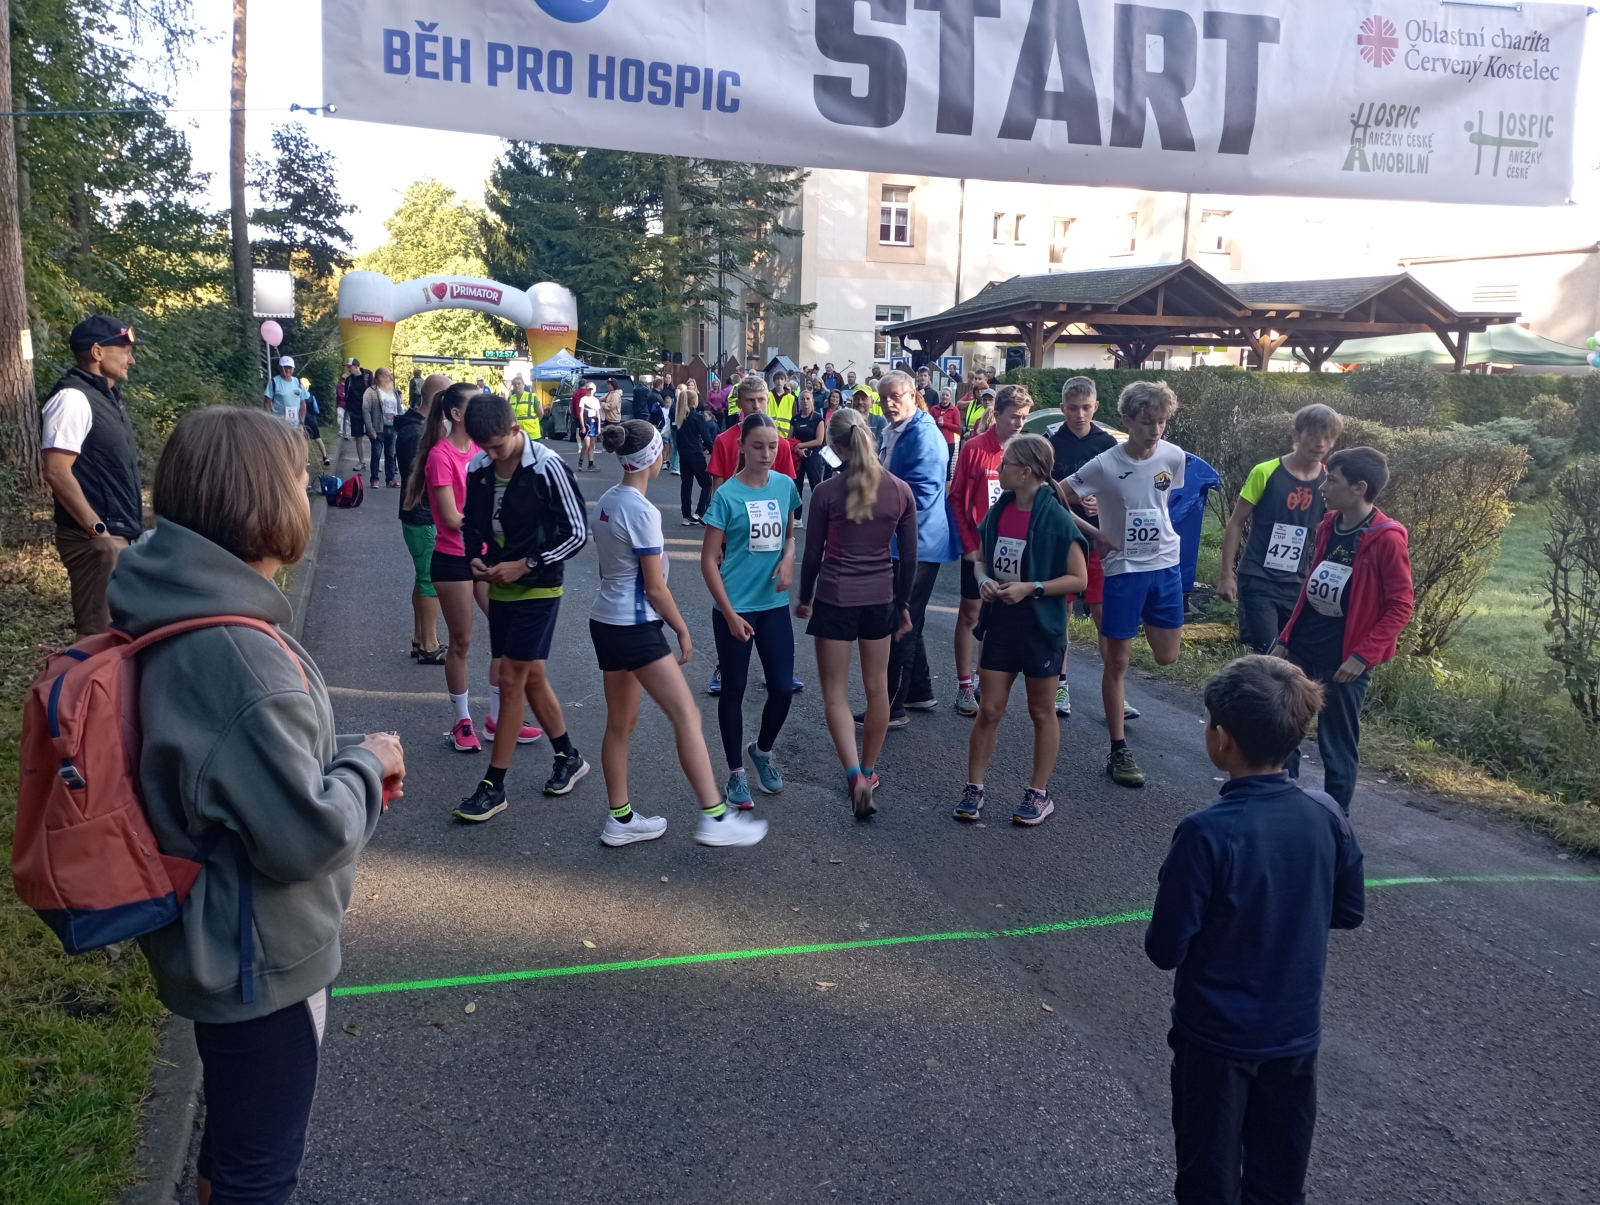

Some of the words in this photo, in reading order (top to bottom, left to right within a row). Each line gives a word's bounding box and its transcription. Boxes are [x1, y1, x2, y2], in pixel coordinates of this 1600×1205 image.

[1405, 19, 1486, 47] Oblastní
[1491, 27, 1551, 53] charita
[383, 20, 471, 84] BĚH
[487, 41, 573, 96] PRO
[587, 53, 741, 114] HOSPIC
[1404, 43, 1483, 83] Červený
[1483, 55, 1560, 81] Kostelec
[813, 0, 1281, 155] START
[1350, 102, 1421, 148] HOSPIC
[1368, 130, 1404, 147] ANEŽKY
[1406, 132, 1435, 149] ČESKÉ
[1372, 150, 1434, 175] MOBILNÍ
[1508, 148, 1543, 165] ANEŽKY
[1506, 164, 1532, 180] ČESKÉ
[452, 284, 499, 302] PRIMATOR
[751, 522, 782, 539] 500
[1126, 527, 1160, 542] 302
[1268, 543, 1301, 561] 473
[994, 556, 1018, 575] 421
[1308, 578, 1340, 603] 301
